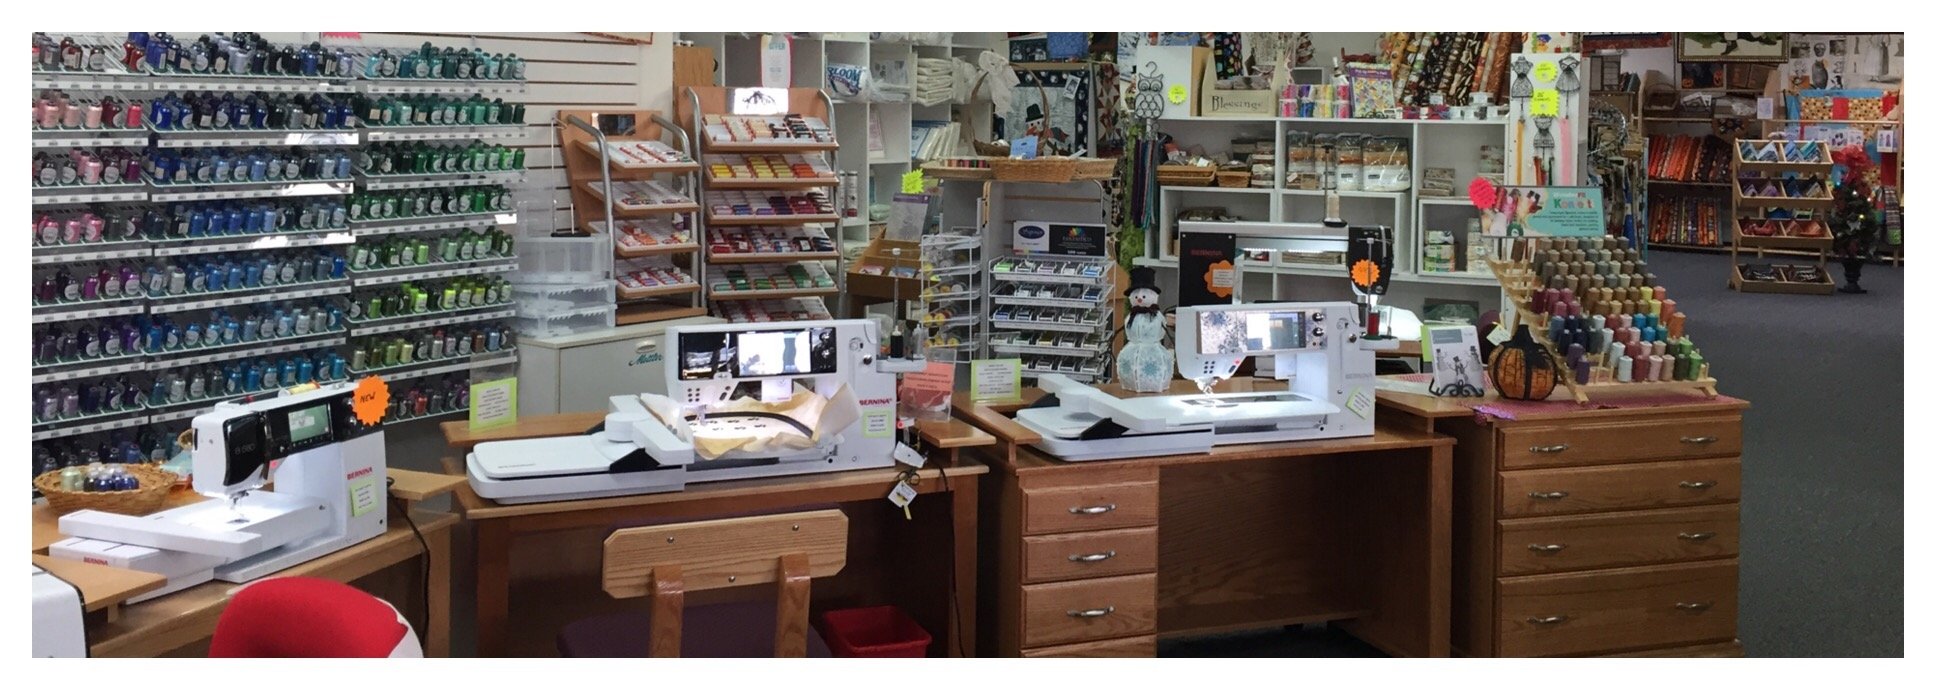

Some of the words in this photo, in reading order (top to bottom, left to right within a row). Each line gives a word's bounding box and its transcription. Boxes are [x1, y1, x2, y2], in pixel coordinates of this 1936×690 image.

[859, 398, 890, 406] BERNINA
[347, 466, 373, 480] BERNINA
[83, 556, 109, 566] BERNINA
